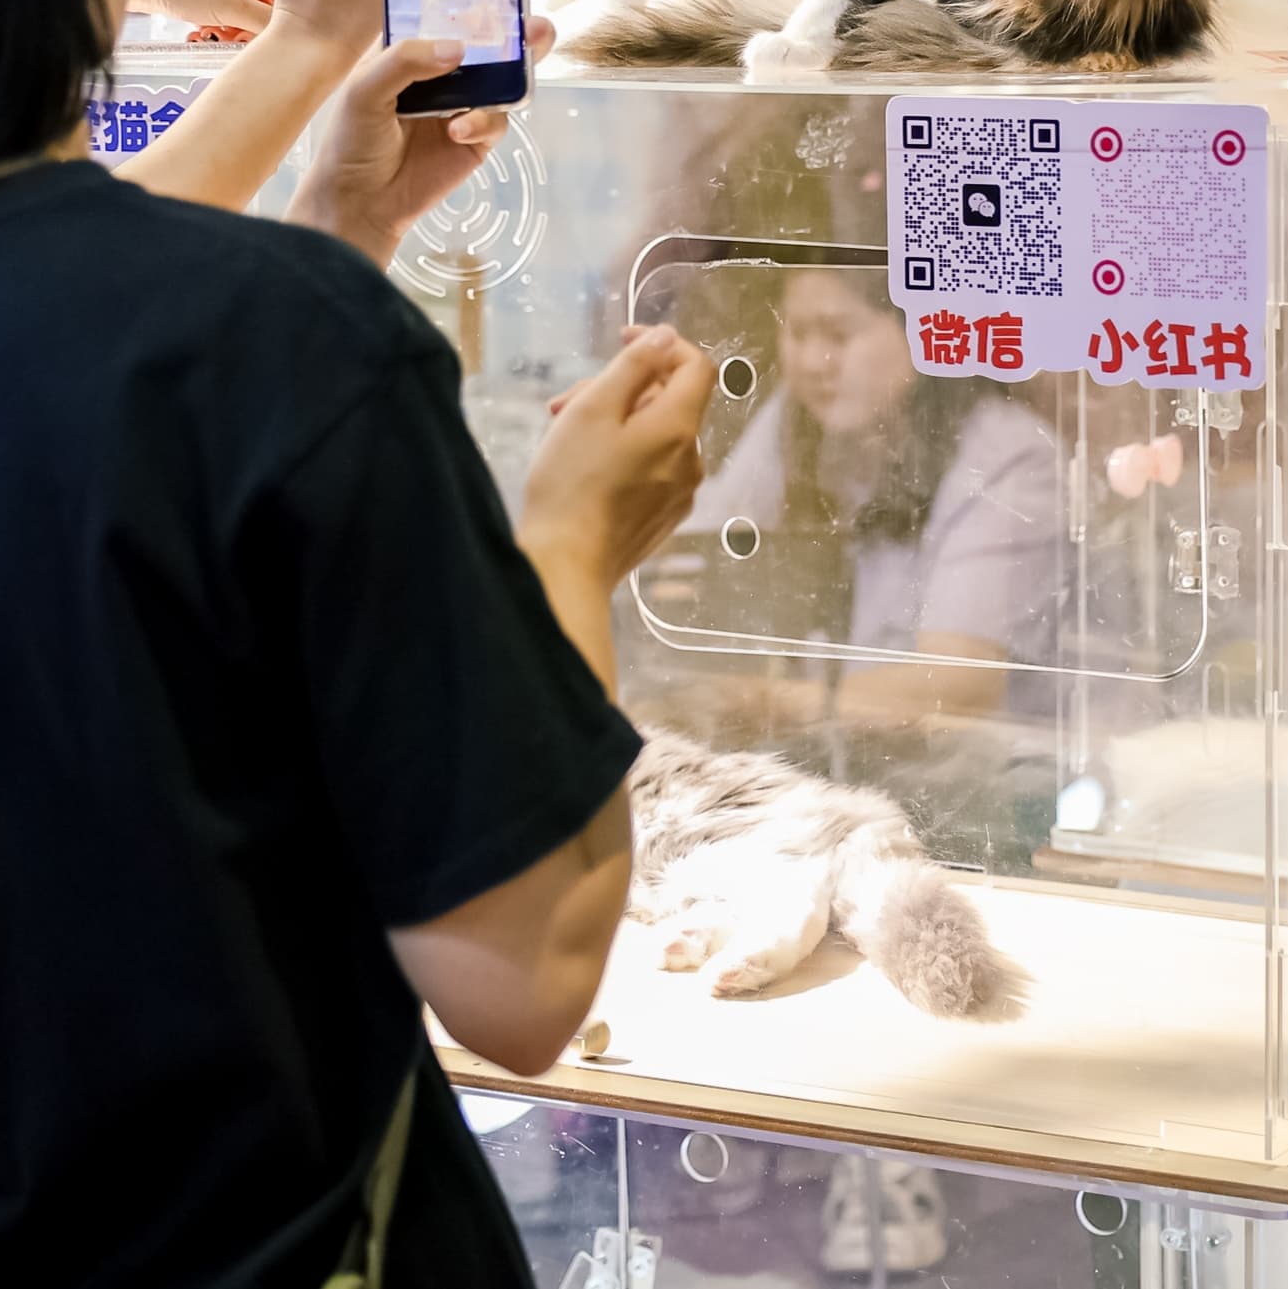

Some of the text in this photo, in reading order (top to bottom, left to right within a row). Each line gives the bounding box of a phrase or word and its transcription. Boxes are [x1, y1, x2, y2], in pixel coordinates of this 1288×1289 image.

[918, 309, 1024, 370] 微信
[1087, 318, 1253, 381] 小红书
